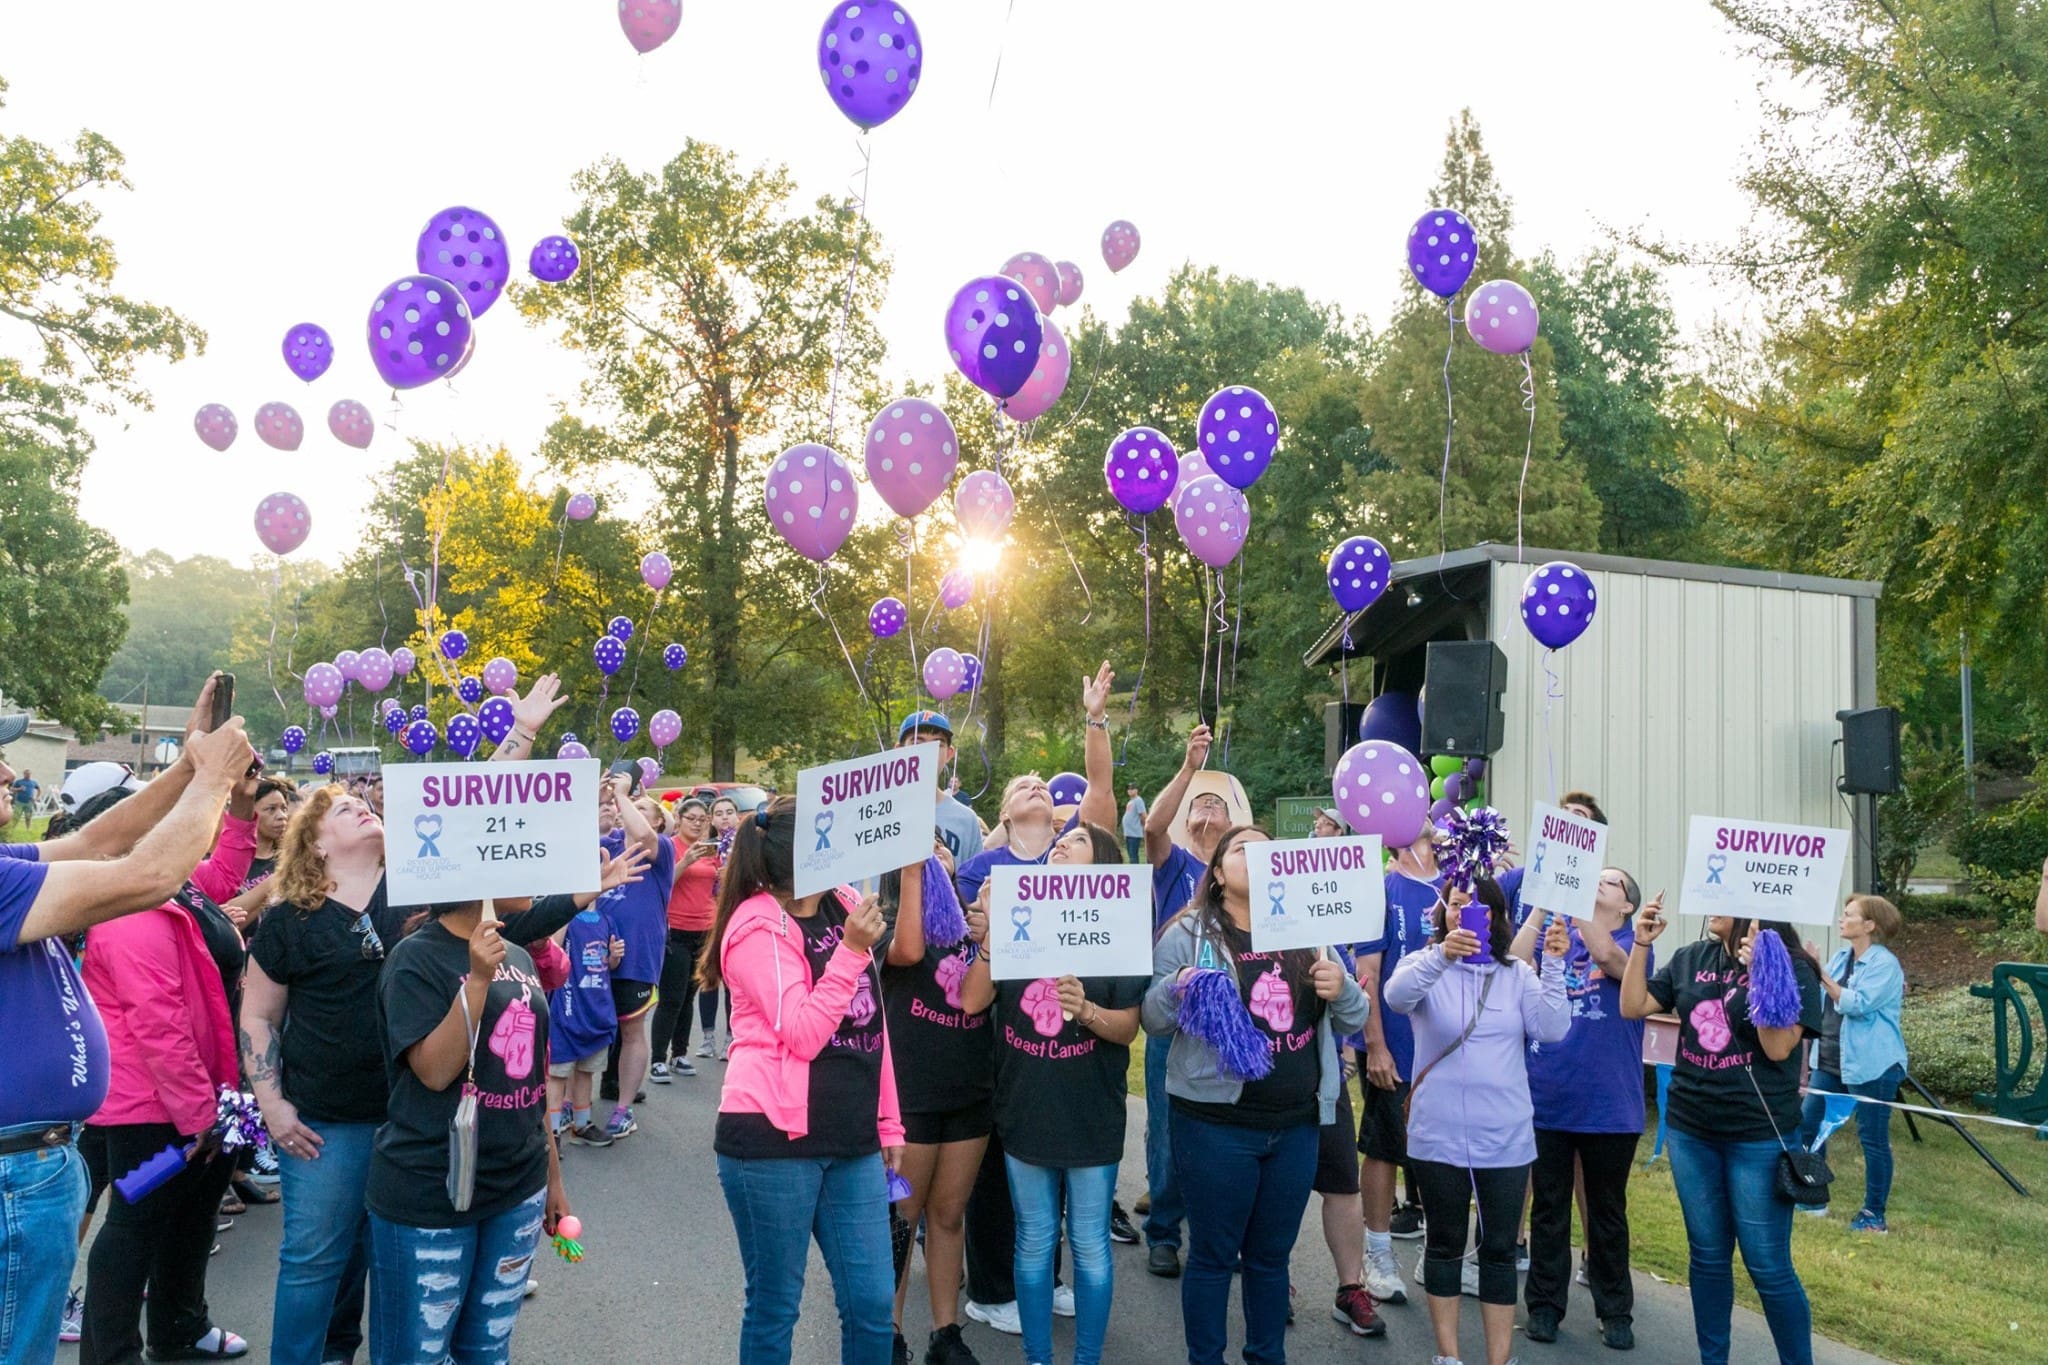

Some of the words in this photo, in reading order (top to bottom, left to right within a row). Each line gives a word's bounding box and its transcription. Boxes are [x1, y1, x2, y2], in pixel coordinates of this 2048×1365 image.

[422, 772, 573, 808] SURVIVOR
[821, 756, 920, 805] SURVIVOR
[858, 800, 892, 821] 16-20
[486, 816, 507, 833] 21
[515, 817, 526, 829] +
[855, 822, 901, 846] YEARS
[1542, 815, 1597, 853] SURVIVOR
[476, 842, 547, 861] YEARS
[1715, 827, 1826, 859] SURVIVOR
[1270, 845, 1365, 876] SURVIVOR
[1566, 855, 1578, 868] 1-5
[1745, 861, 1798, 876] UNDER
[1803, 866, 1810, 877] 1
[1018, 873, 1131, 901] SURVIVOR
[1311, 881, 1338, 895] 6-10
[1554, 871, 1580, 890] YEARS
[1752, 881, 1793, 895] YEAR
[1060, 909, 1100, 923] 11-15
[1306, 901, 1352, 917] YEARS
[1057, 932, 1111, 946] YEARS
[911, 998, 960, 1028] Breast
[65, 1020, 88, 1087] What's
[1048, 1039, 1097, 1059] Cancer
